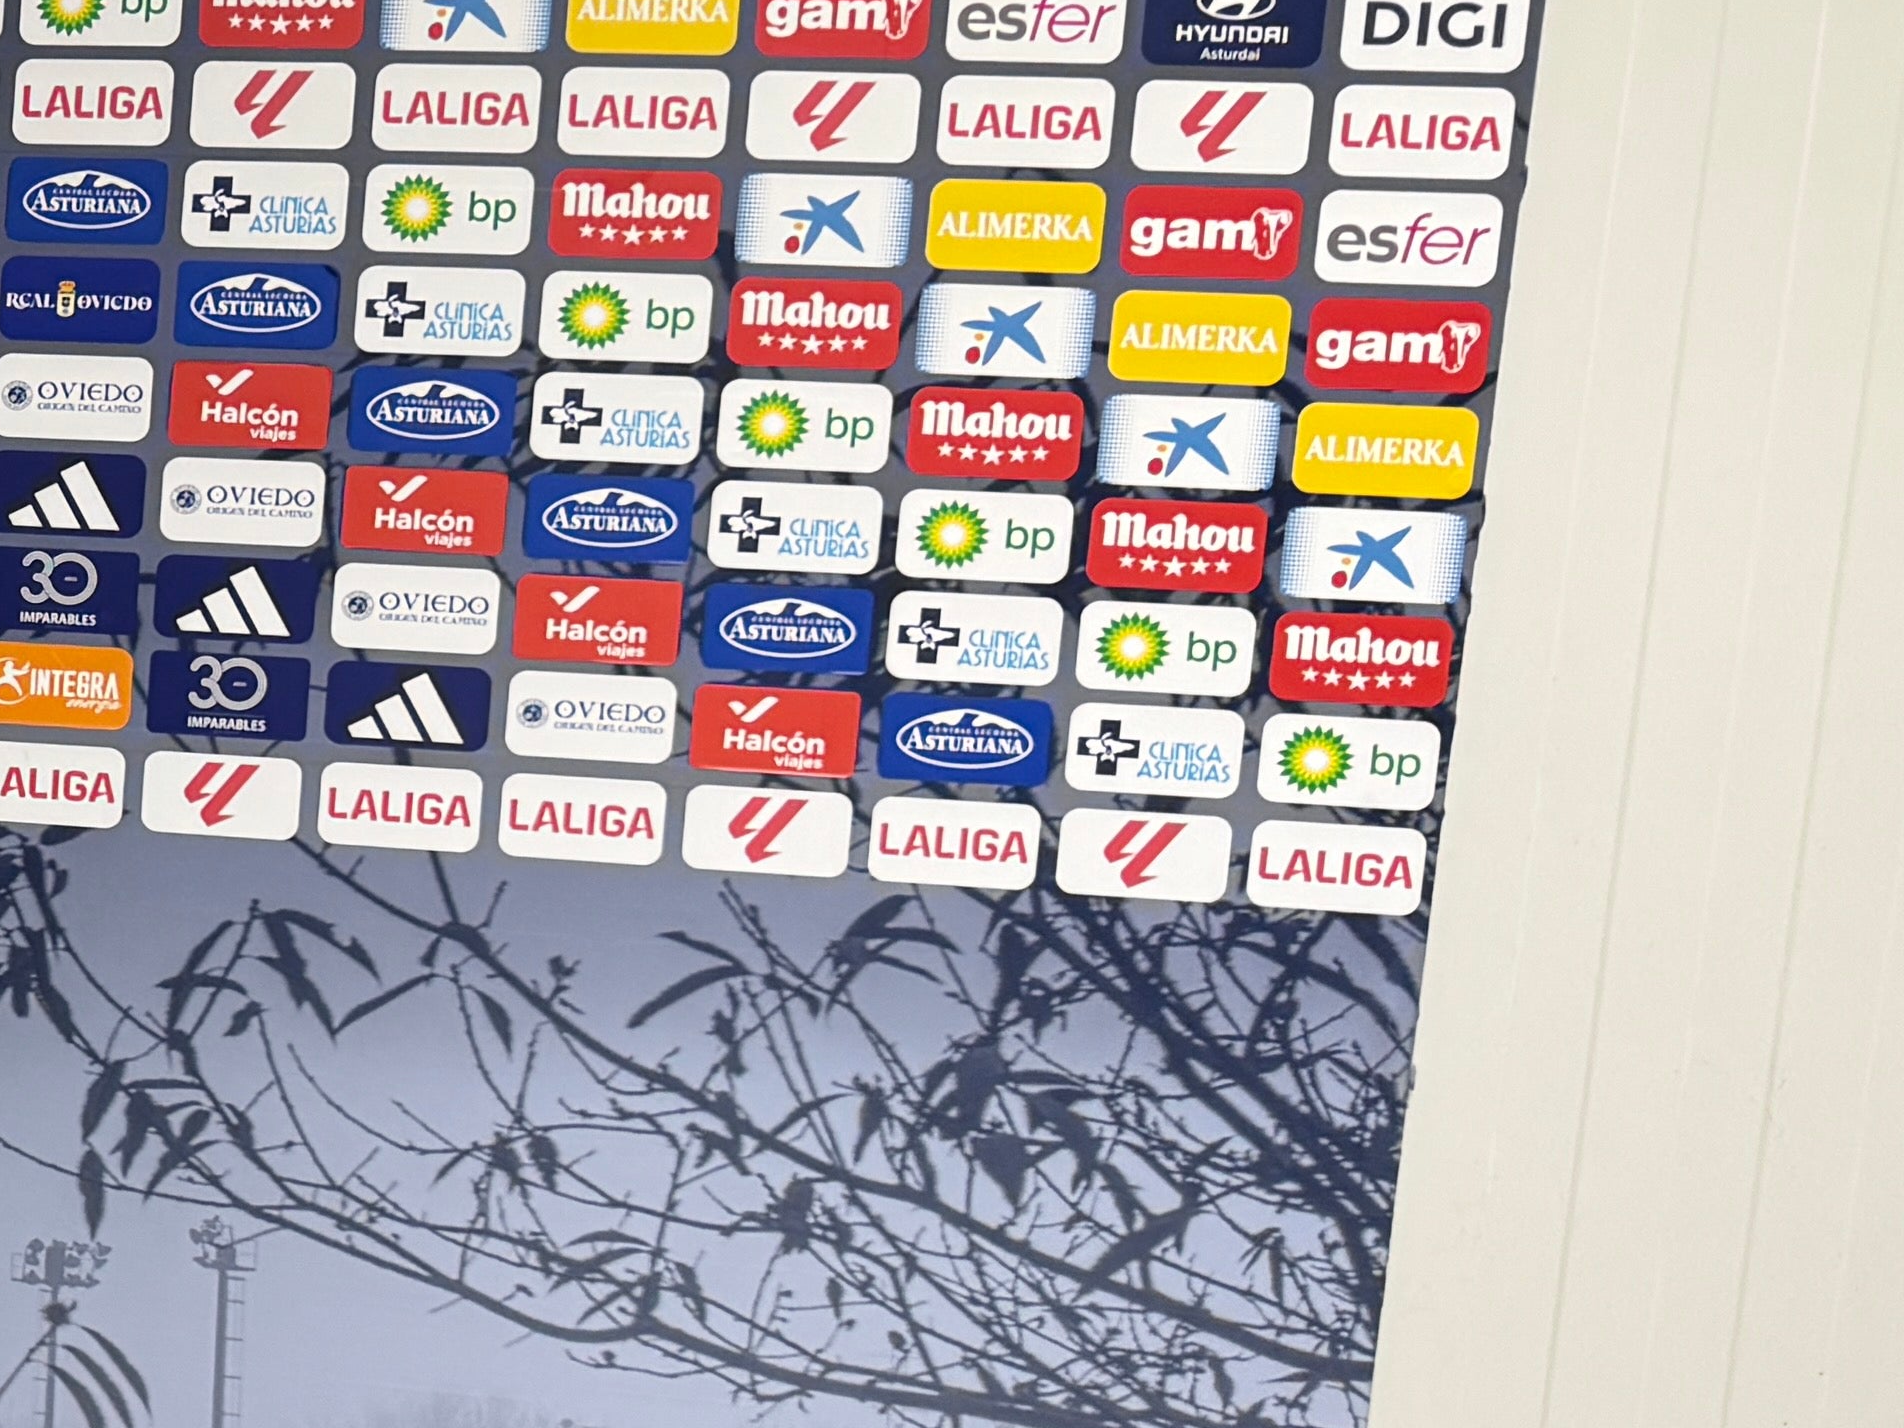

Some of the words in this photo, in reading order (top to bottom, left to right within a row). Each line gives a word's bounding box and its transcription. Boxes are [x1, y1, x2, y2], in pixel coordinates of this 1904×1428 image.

[1363, 2, 1507, 47] DIGI
[382, 91, 530, 127] LALIGA
[1340, 114, 1502, 151] LALIGA
[31, 188, 141, 214] ASTURIANA
[562, 182, 710, 220] Mahou
[940, 212, 1092, 240] ALIMERKA
[1327, 213, 1490, 264] esfer
[38, 381, 144, 403] OVIEDO
[1306, 436, 1463, 466] ALIMERKA
[1006, 519, 1054, 558] bp
[728, 616, 846, 644] ASTURIANA
[1285, 625, 1439, 667] Mahou
[30, 668, 120, 701] INTEGRA
[188, 655, 268, 711] 30
[187, 716, 267, 732] IMPARABLES
[723, 728, 825, 755] Halcón
[774, 754, 823, 770] viajes
[1371, 745, 1420, 785] bp
[1258, 848, 1413, 889] LALIGA
